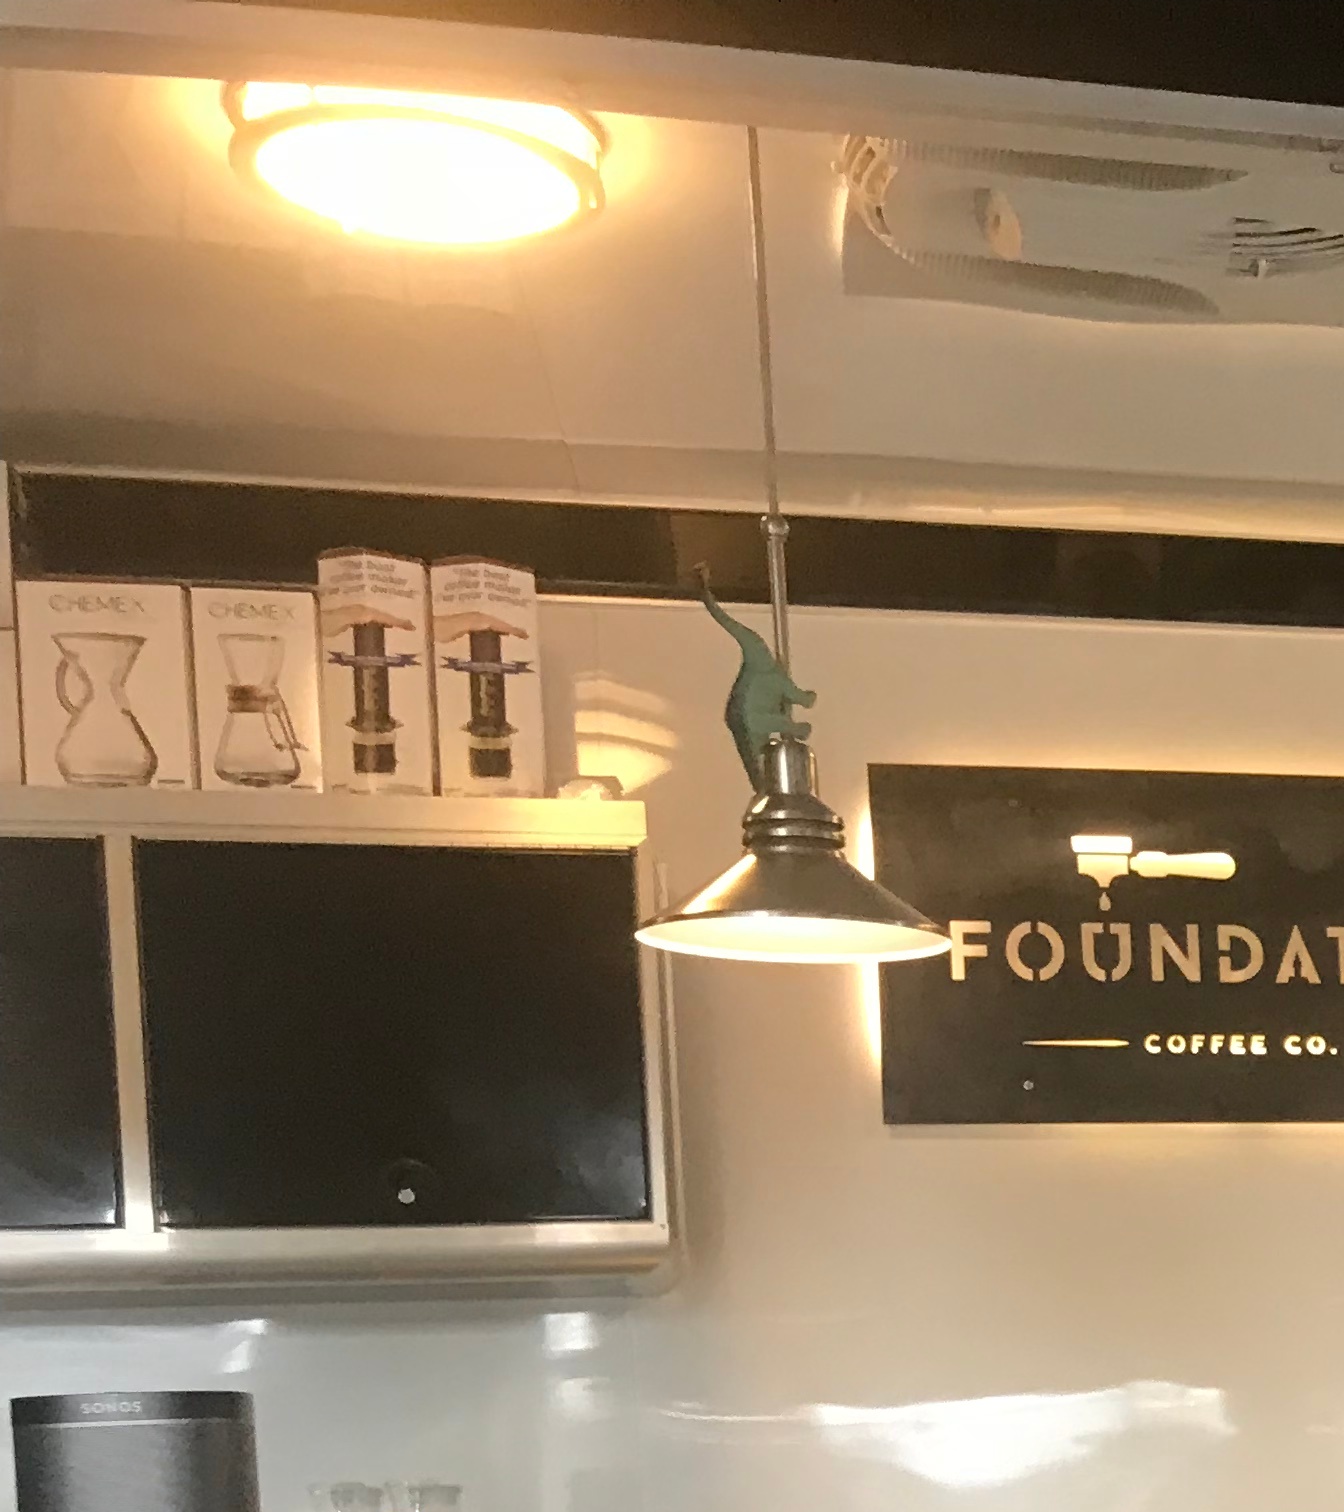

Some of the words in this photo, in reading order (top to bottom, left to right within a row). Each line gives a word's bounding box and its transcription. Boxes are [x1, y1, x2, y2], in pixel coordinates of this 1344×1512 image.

[48, 594, 146, 613] CHEMEX
[207, 601, 297, 620] CHEMEX
[1143, 1034, 1268, 1056] COFFEE
[1283, 1034, 1338, 1056] CO.
[80, 1401, 142, 1414] SONOS
